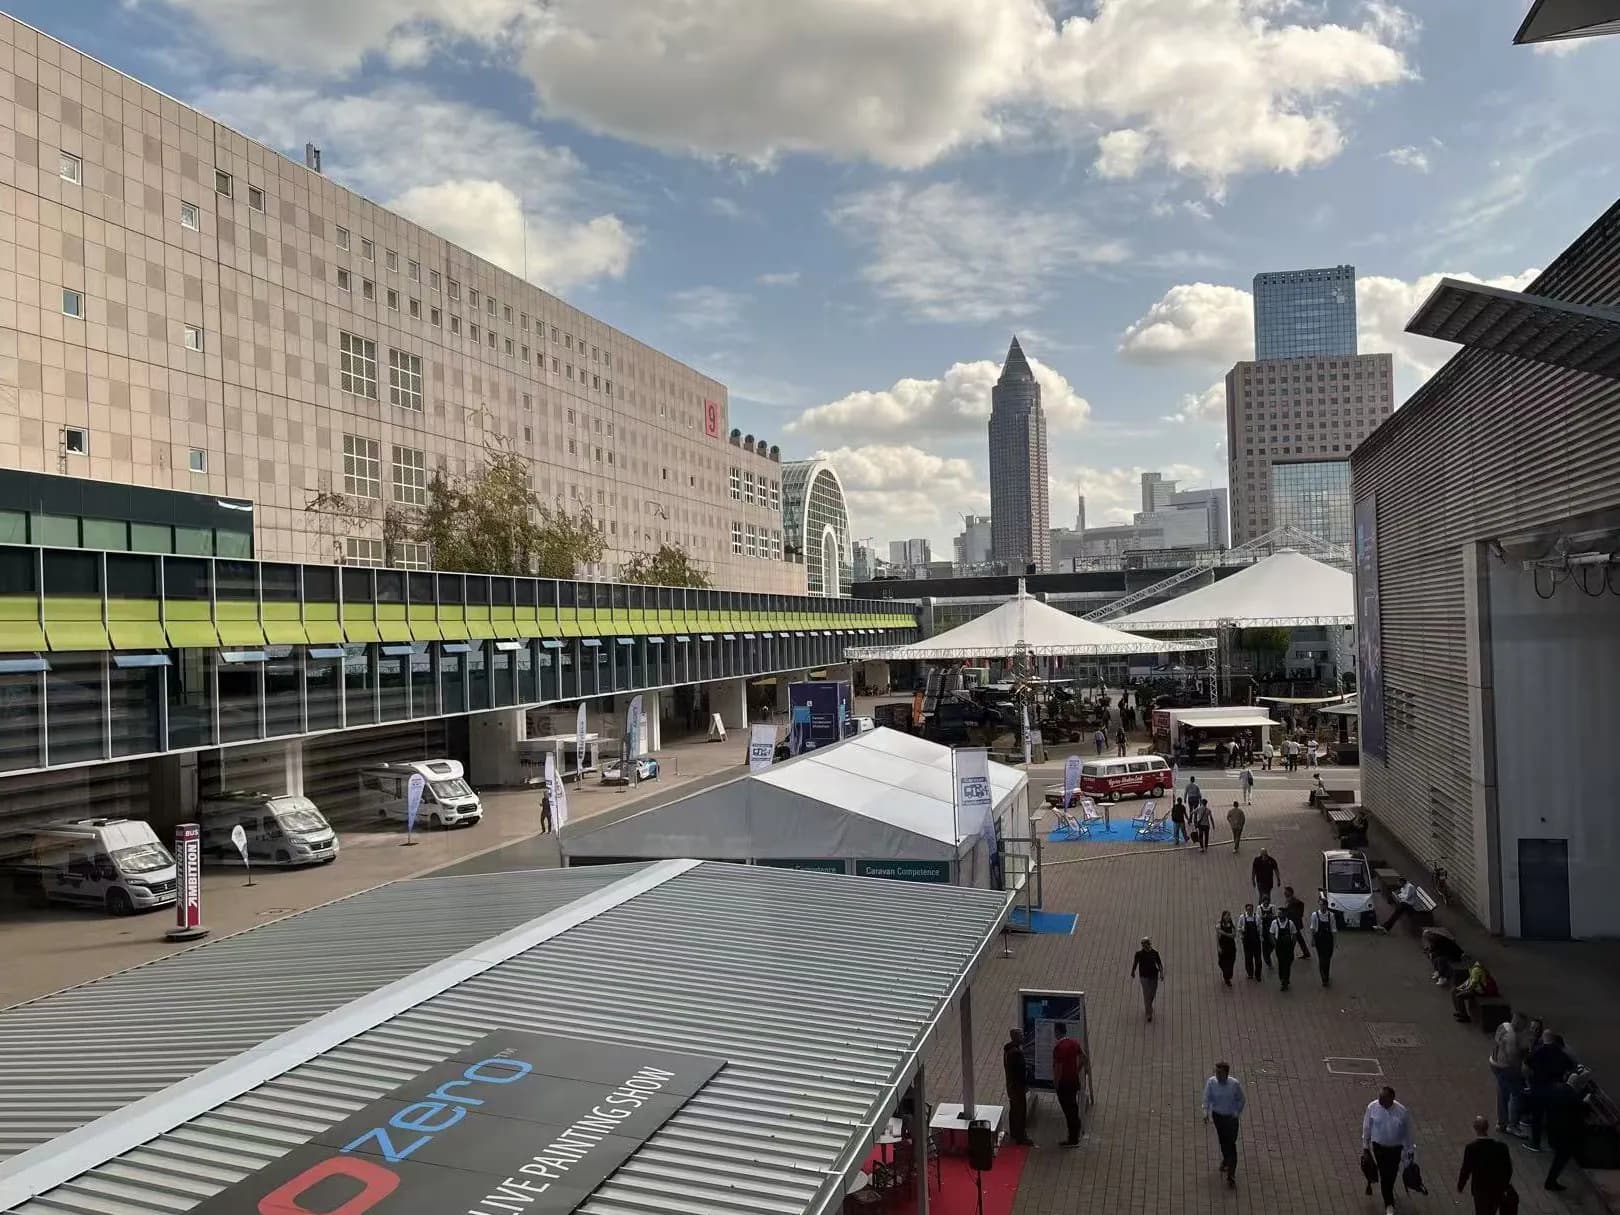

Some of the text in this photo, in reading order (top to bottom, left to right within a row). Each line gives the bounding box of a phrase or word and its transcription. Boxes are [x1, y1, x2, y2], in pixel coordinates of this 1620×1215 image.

[709, 405, 715, 432] 9
[187, 844, 198, 907] AMBITION
[865, 866, 940, 878] Caravan Competence
[519, 1106, 632, 1178] PAINTING
[605, 1066, 676, 1108] SHOW
